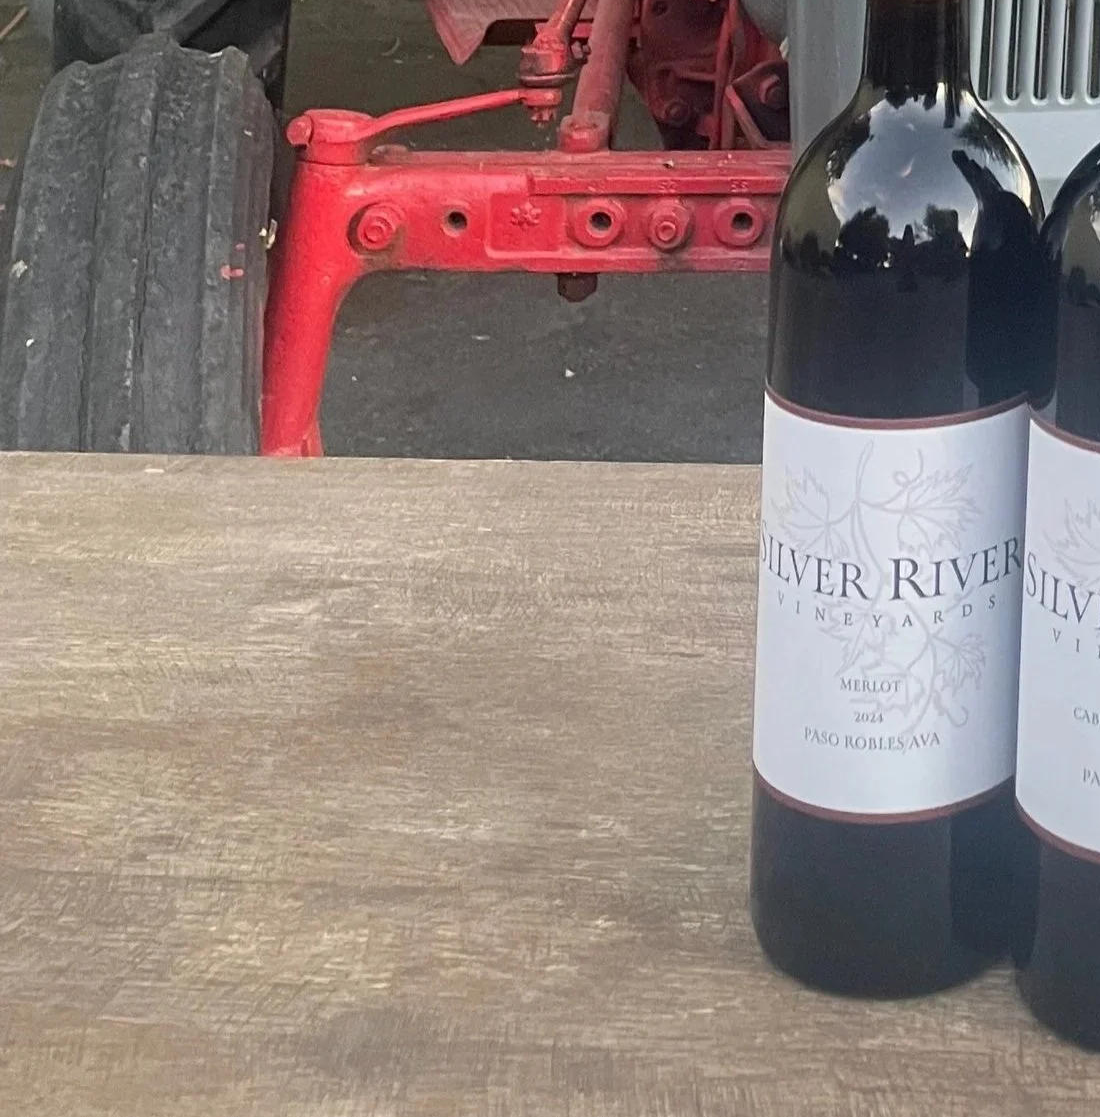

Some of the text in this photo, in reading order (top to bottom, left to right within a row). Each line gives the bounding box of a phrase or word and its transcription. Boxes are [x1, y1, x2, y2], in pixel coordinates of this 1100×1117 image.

[761, 519, 1021, 601] SILVER RIVER
[778, 590, 996, 628] VINEYARDS
[840, 676, 901, 693] MERLOT
[854, 711, 884, 723] 2024
[804, 726, 941, 751] PASO ROBLES AVA
